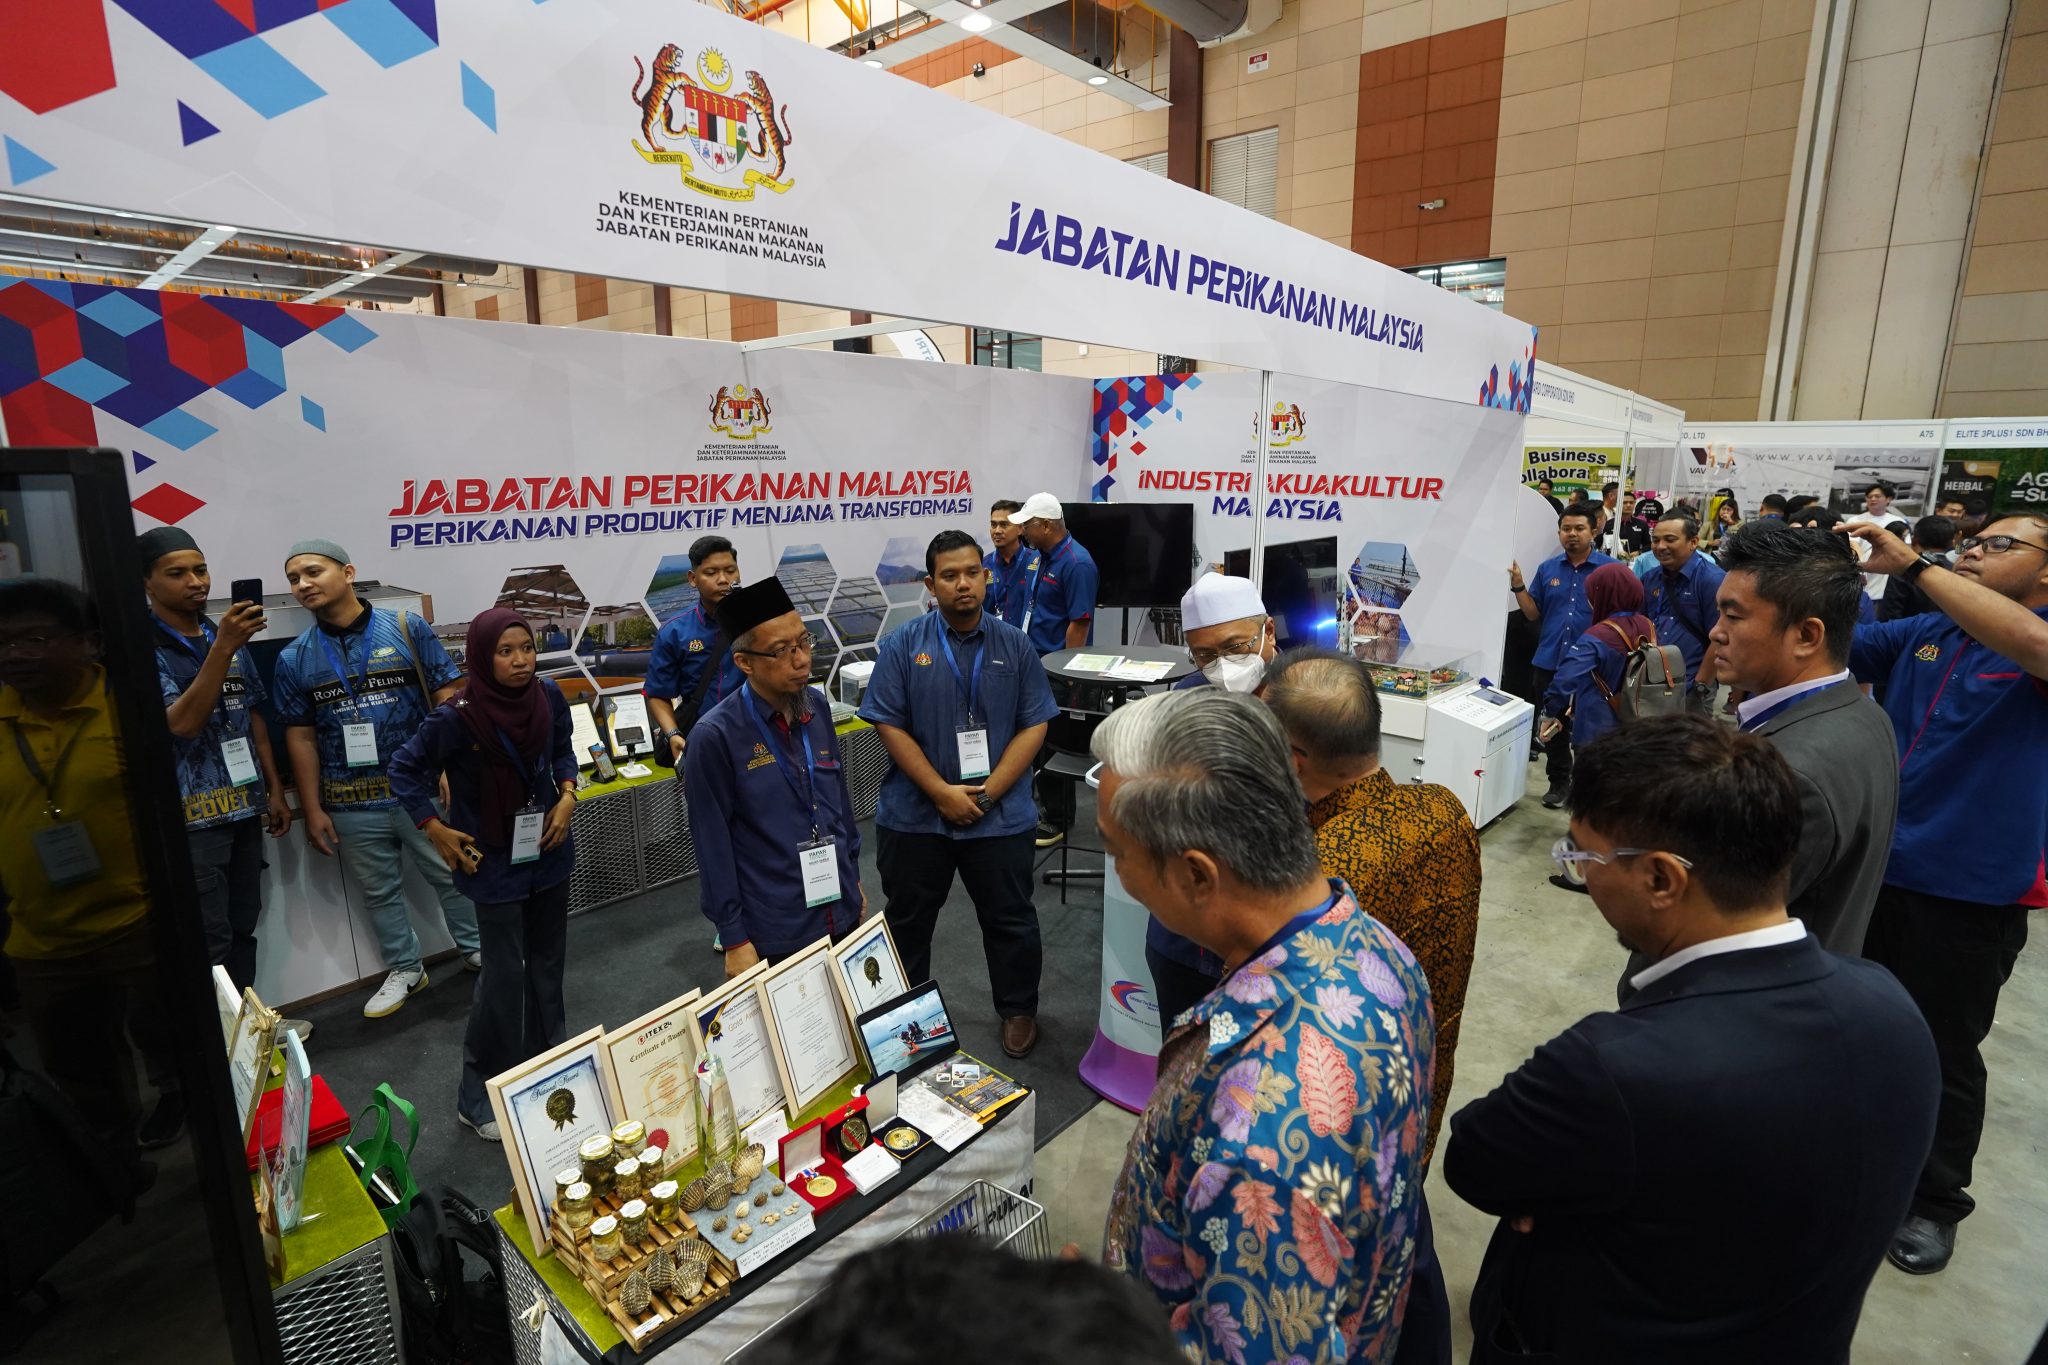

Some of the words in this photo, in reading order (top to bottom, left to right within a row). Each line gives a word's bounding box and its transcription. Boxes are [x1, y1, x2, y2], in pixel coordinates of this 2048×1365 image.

[652, 153, 684, 163] BERSEKUTU
[684, 176, 713, 194] BERTAMBAH
[713, 188, 728, 198] MUTU
[618, 190, 729, 222] KEMENTERIAN
[733, 213, 808, 239] PERTANIAN
[599, 203, 635, 221] DAN
[640, 211, 754, 242] KETERJAMINAN
[759, 234, 824, 255] MAKANAN
[596, 218, 670, 243] JABATAN
[675, 233, 758, 258] PERIKANAN
[763, 248, 826, 269] MALAYSIA
[995, 201, 1180, 292] JABATAN
[1186, 254, 1336, 331] PERIKANAN
[1339, 299, 1424, 352] MALAYSIA
[1693, 432, 1706, 440] LTD
[1920, 430, 1934, 438] A75
[1956, 430, 1980, 438] ELITE
[1981, 429, 2013, 438] 3PLUS1
[2016, 428, 2034, 437] SDN
[2037, 428, 2048, 436] BH
[1528, 448, 1607, 465] Business
[1138, 470, 1252, 493] INDUSTRI
[1944, 481, 1983, 491] HERBAL
[388, 475, 611, 518] JABATAN
[623, 471, 832, 507] PERIKANAN
[838, 470, 973, 499] MALAYSIA
[1212, 496, 1342, 522] MAAYSIA
[390, 516, 577, 549] PERIKANAN
[584, 506, 727, 536] PRODUKTIF
[731, 503, 835, 527] MENJANA
[839, 498, 973, 521] TRANSFORMASI
[313, 686, 347, 701] ROYA
[184, 790, 250, 822] COVET
[630, 1043, 660, 1063] Certificate
[667, 1028, 686, 1043] Award
